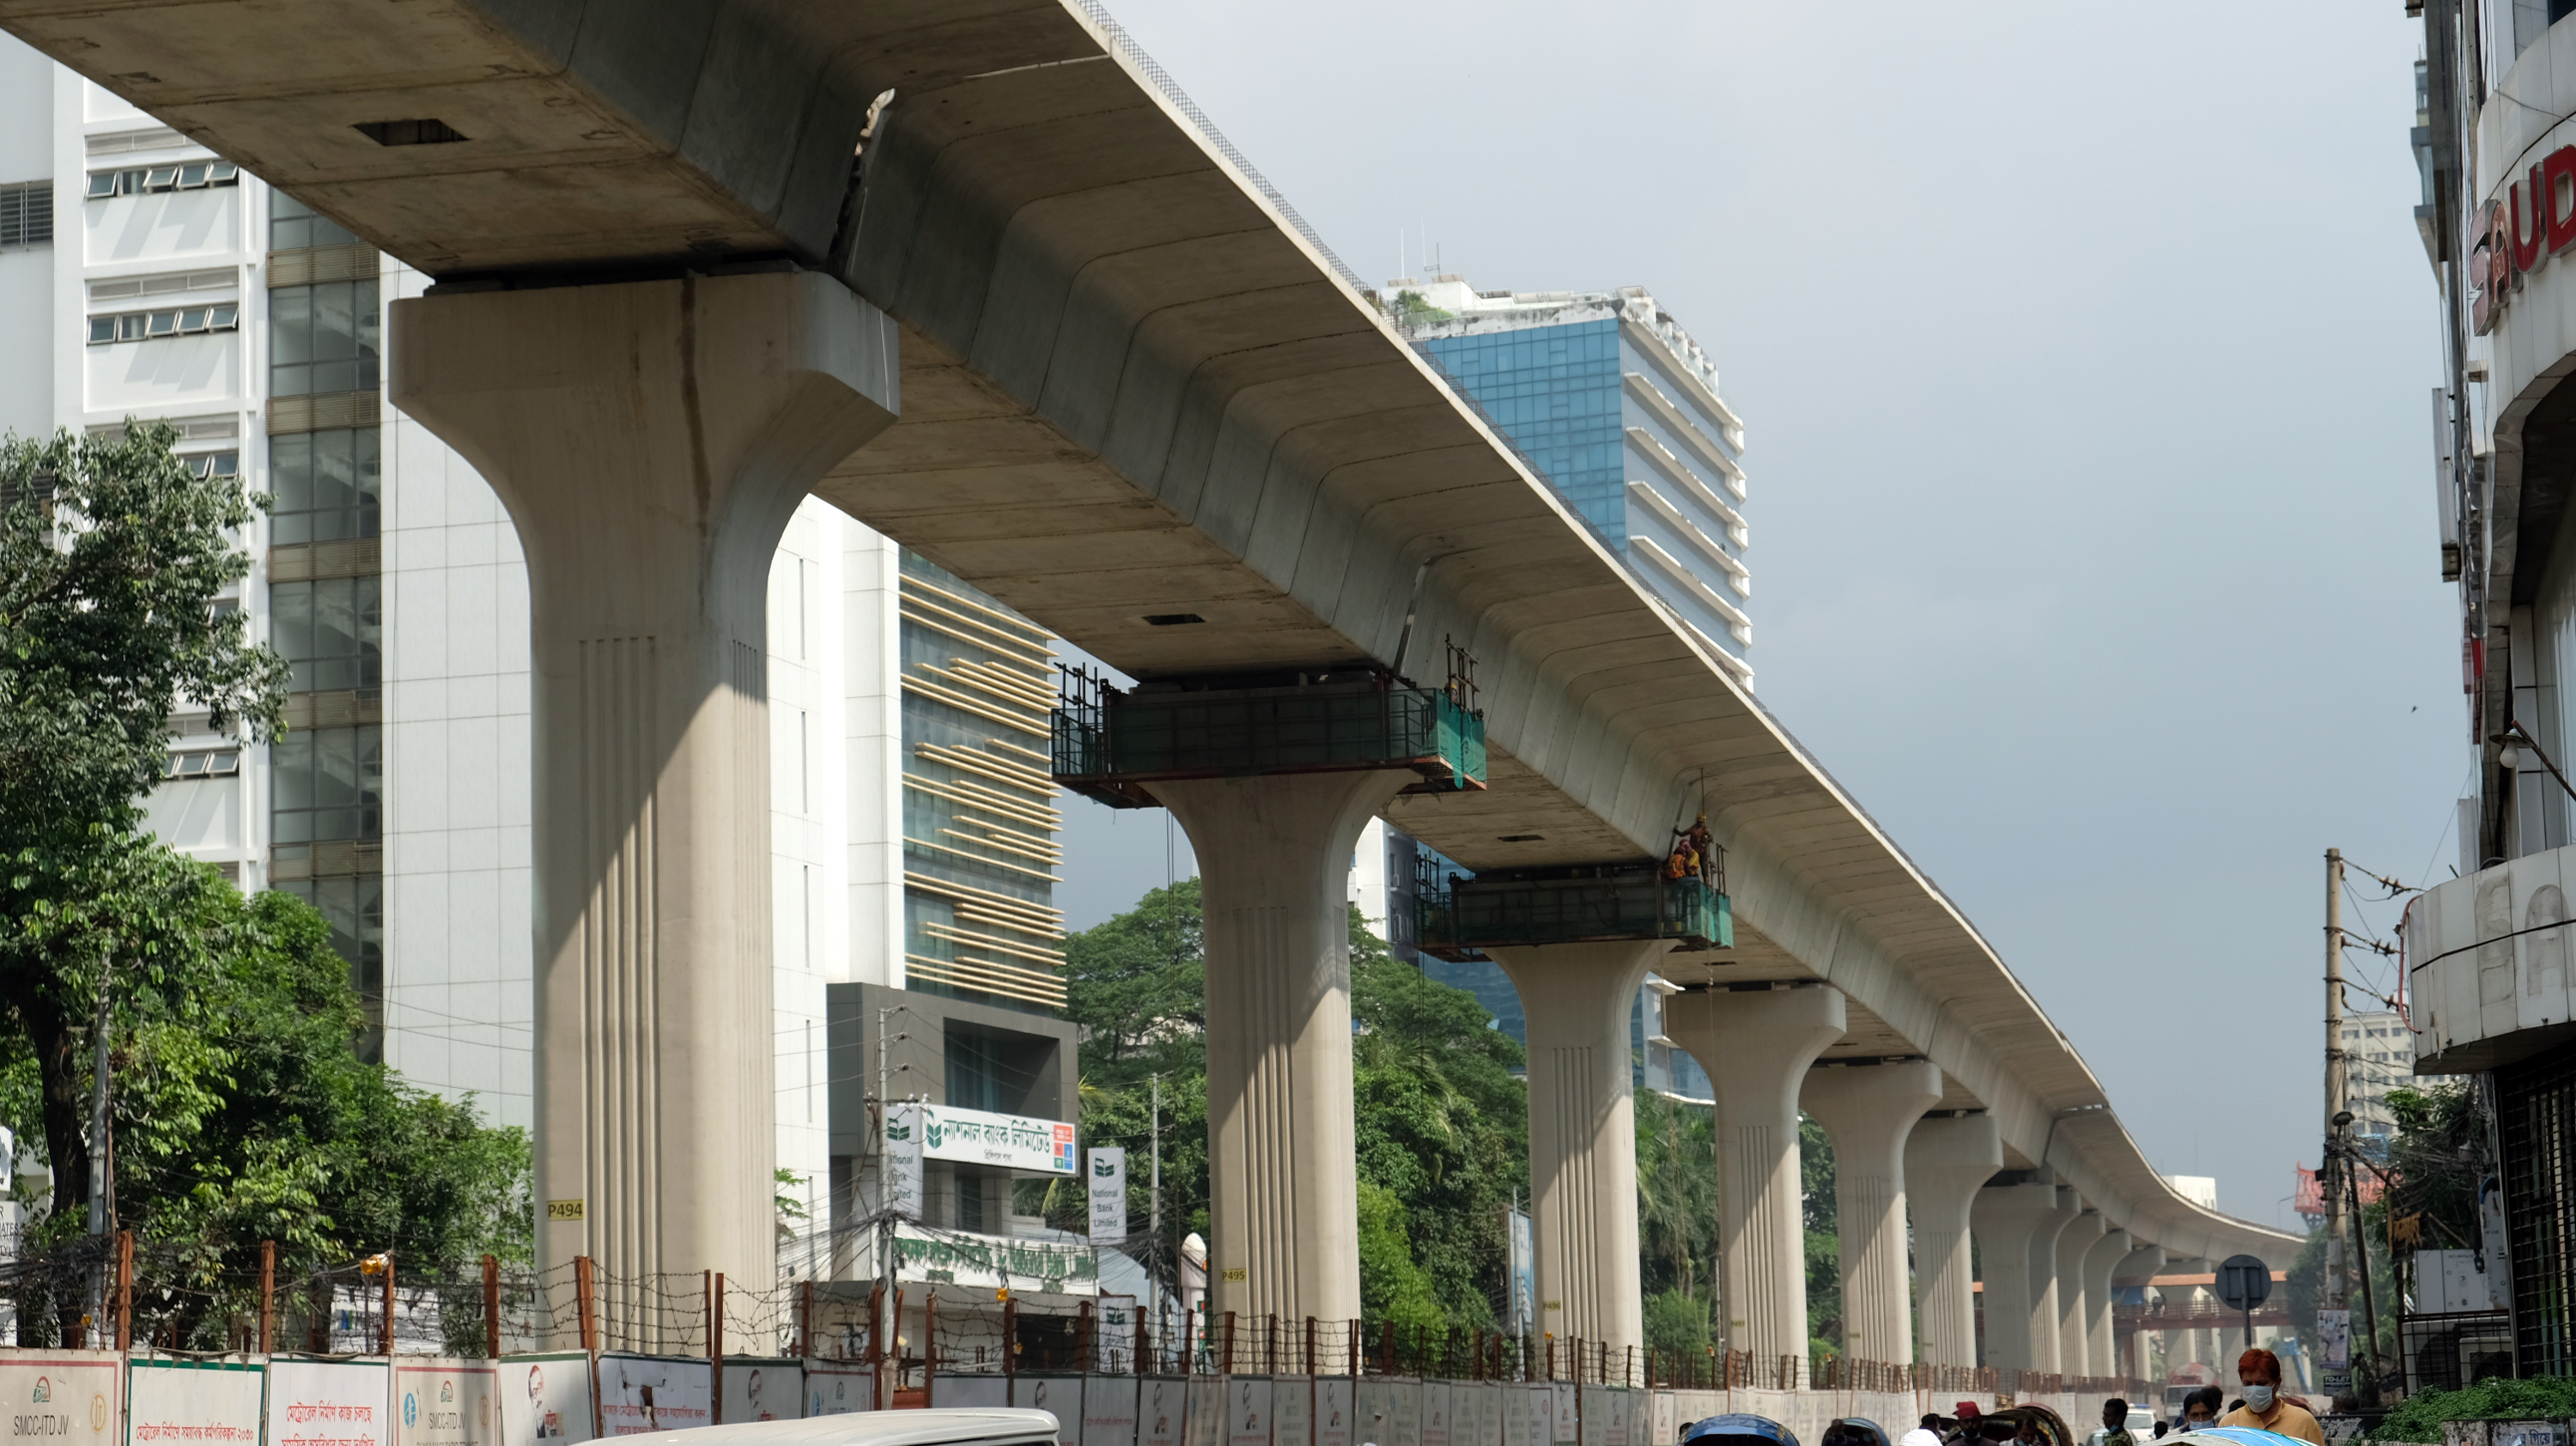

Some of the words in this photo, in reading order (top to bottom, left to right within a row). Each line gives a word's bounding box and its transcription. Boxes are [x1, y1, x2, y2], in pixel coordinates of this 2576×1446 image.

[943, 1119, 981, 1144] ন্যাশনাল
[983, 1124, 1009, 1147] ব্যাংক
[1011, 1119, 1050, 1153] লিমিটেড
[1091, 1189, 1118, 1199] National
[548, 1202, 583, 1218] P494
[1097, 1204, 1113, 1212] Bank
[1093, 1218, 1117, 1228] Limited
[1222, 1271, 1245, 1280] P495
[1543, 1302, 1561, 1310] P496
[286, 1399, 317, 1424] মেট্রোরেল
[318, 1400, 337, 1423] নির্মাণ
[338, 1405, 353, 1423] কাজ
[354, 1406, 373, 1425] চলছে
[14, 1414, 56, 1436] SMCC-ITD
[58, 1414, 70, 1436] JV
[428, 1413, 458, 1430] SMCC-ITD
[458, 1413, 466, 1429] JV
[137, 1422, 161, 1441] মেট্রোরেল
[161, 1421, 179, 1440] নির্মাণে
[237, 1428, 254, 1442] ২০৩০
